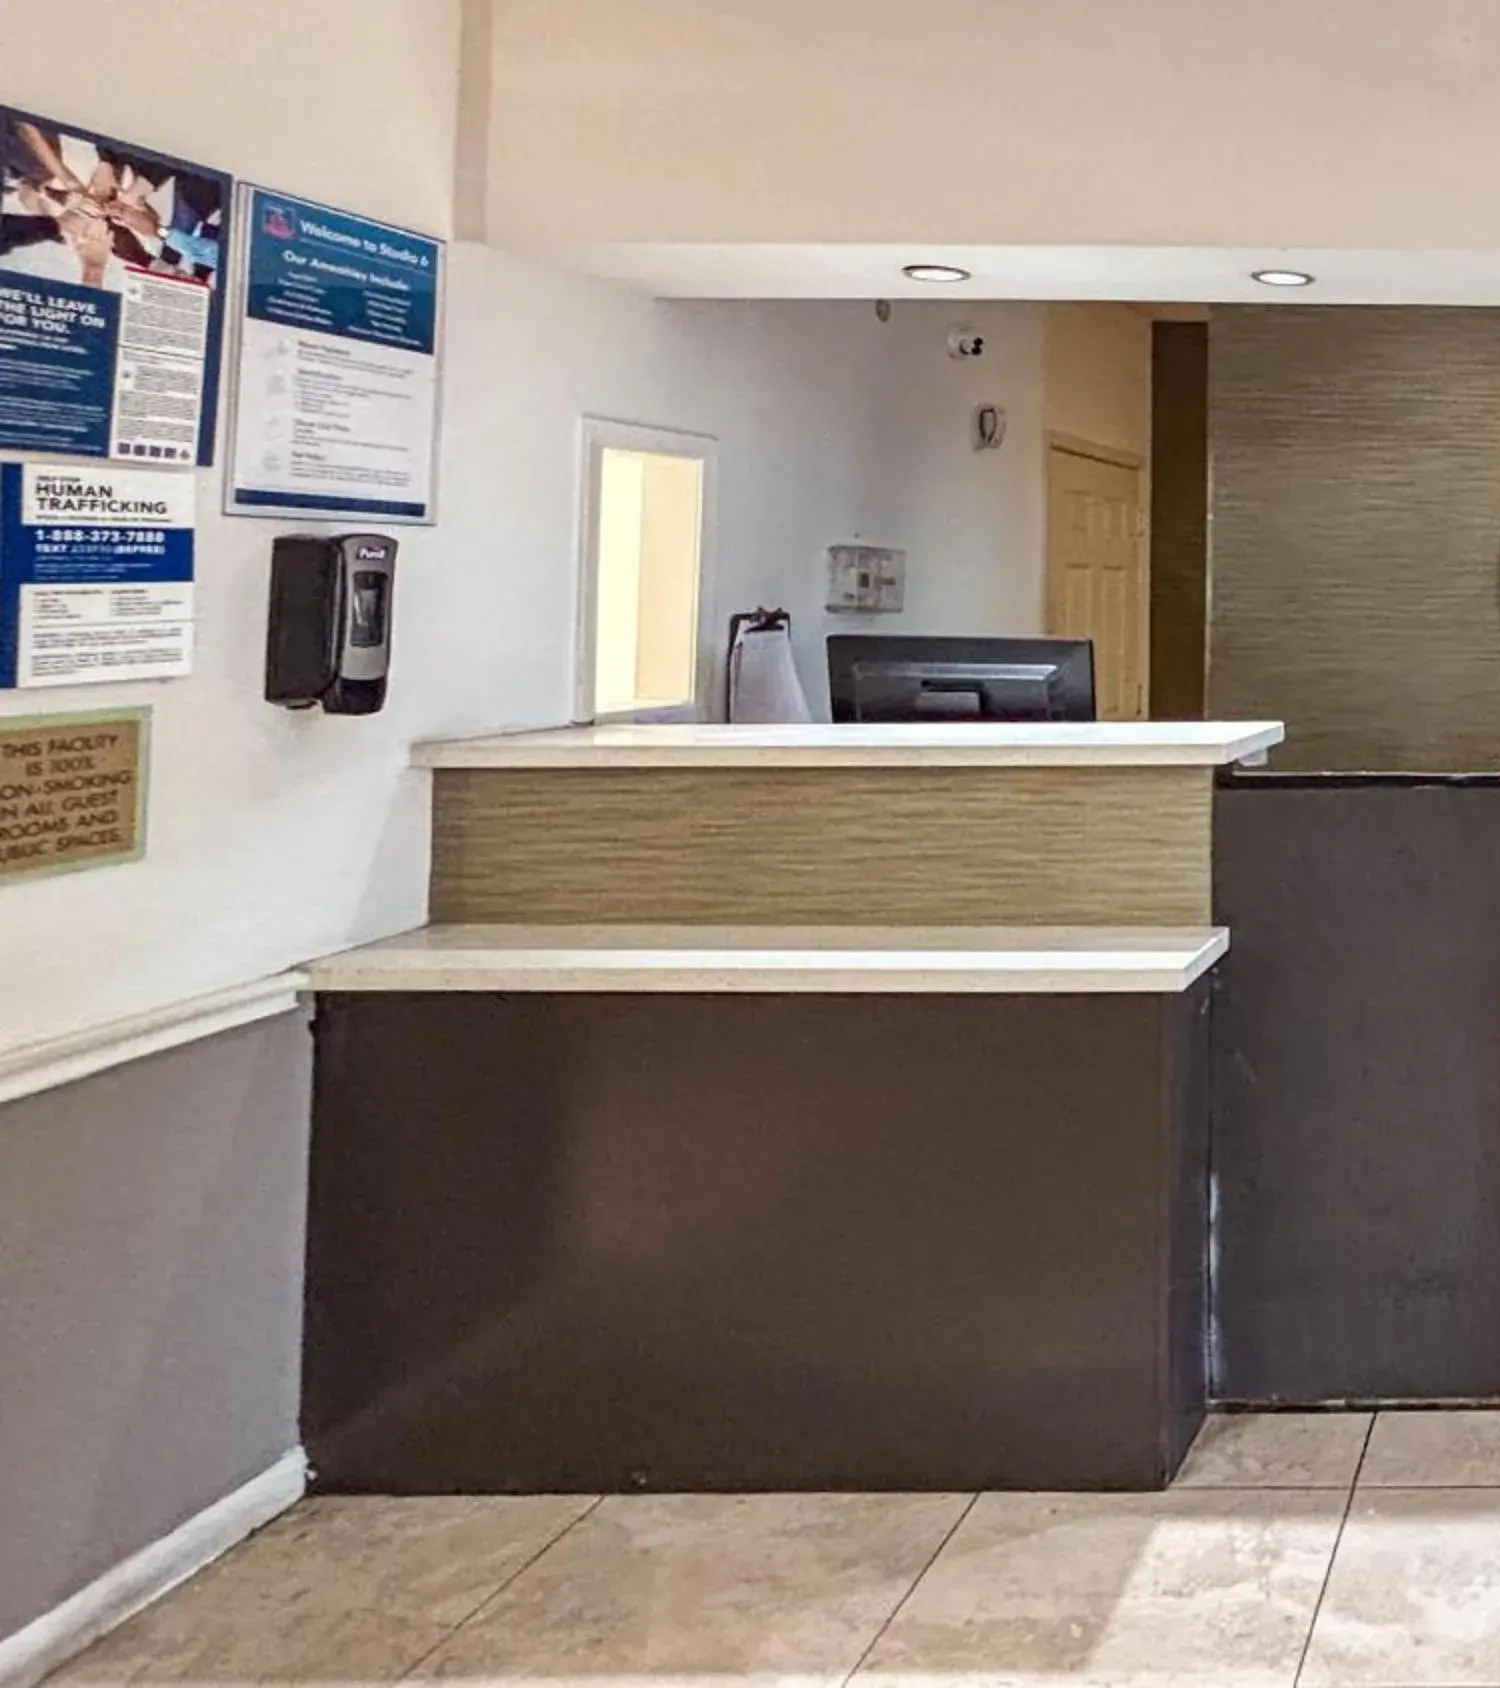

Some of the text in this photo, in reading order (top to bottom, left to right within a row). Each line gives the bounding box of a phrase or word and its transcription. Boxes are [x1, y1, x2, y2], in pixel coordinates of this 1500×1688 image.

[299, 219, 362, 248] Welcome
[362, 239, 377, 253] to
[379, 242, 419, 265] Studio
[281, 249, 307, 265] Our
[47, 295, 97, 314] LEAVE
[30, 305, 77, 322] LIGHT
[80, 314, 106, 329] ON
[36, 482, 113, 498] HUMAN
[36, 497, 168, 514] TRAFFICKING
[47, 734, 119, 755] FACILITY
[25, 761, 43, 776] IS
[61, 790, 119, 812] GUEST
[75, 809, 119, 828] AND
